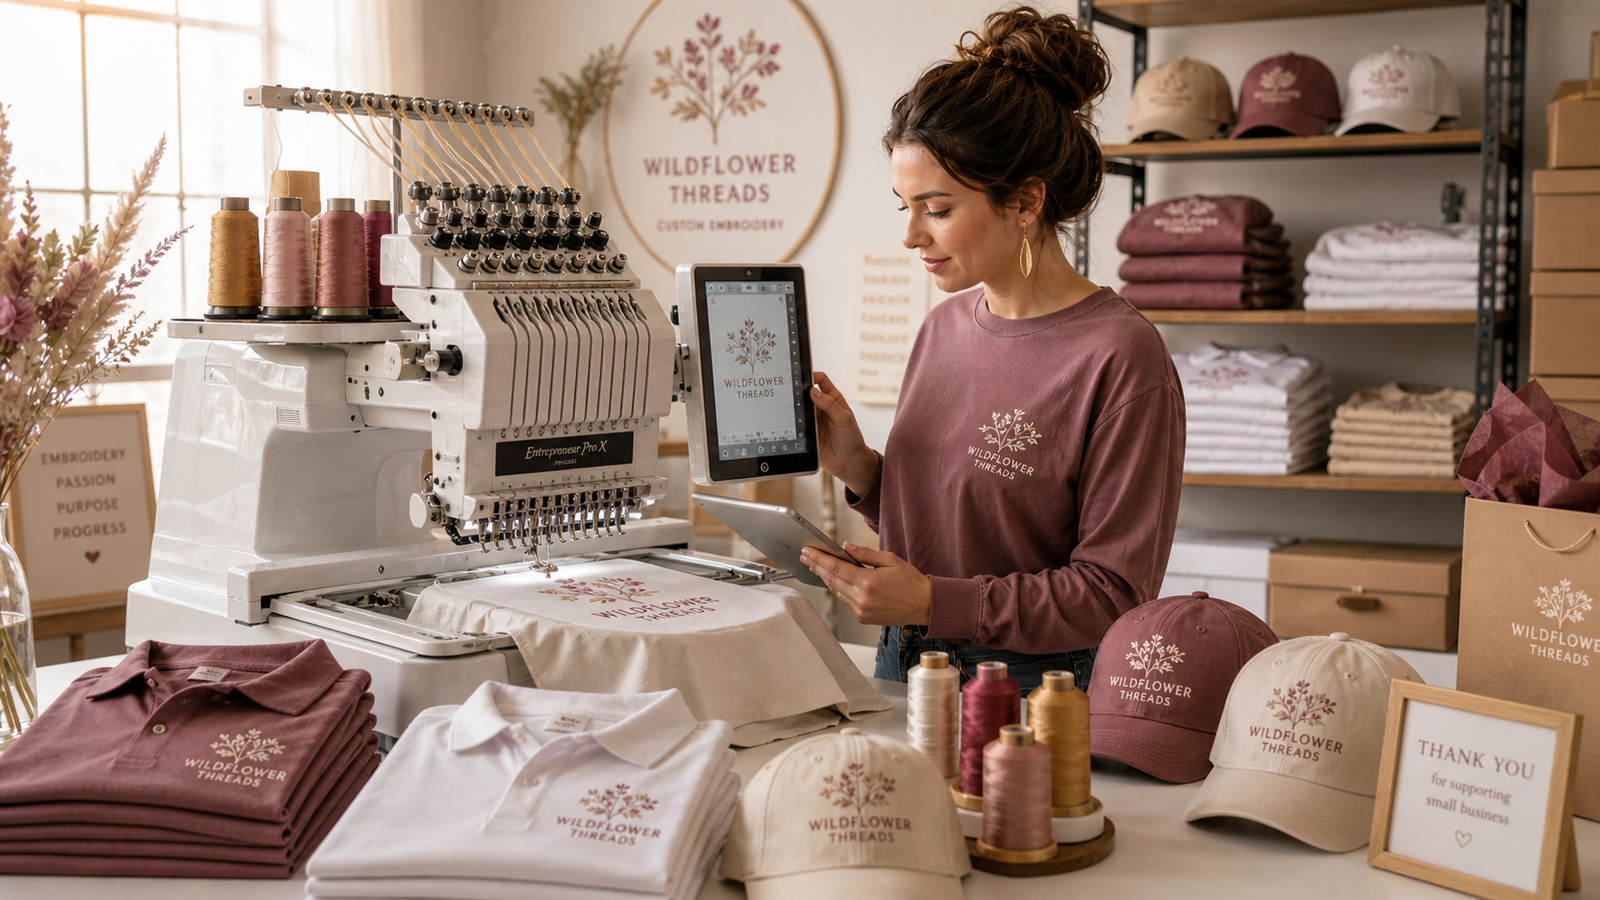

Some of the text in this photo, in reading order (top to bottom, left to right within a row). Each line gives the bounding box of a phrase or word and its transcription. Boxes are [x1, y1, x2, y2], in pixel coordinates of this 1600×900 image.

[643, 153, 797, 177] WILDFLOWER
[669, 183, 771, 204] THREADS
[656, 218, 785, 232] CUSTOM EMBROIDERY
[724, 376, 785, 388] WILDFLOWER
[736, 389, 775, 399] THREADS
[41, 448, 126, 466] EMBROIDERY
[525, 440, 608, 459] Entrepreneur Pro X
[968, 445, 1034, 476] WILDFLOWER
[974, 459, 1016, 480] THREADS
[55, 473, 117, 489] PASSION
[56, 498, 120, 514] PURPOSE
[53, 521, 127, 540] PROGRESS
[591, 596, 720, 619] WILDFLOWER
[636, 605, 716, 622] THREADS
[1511, 622, 1600, 653] WILDFLOWE
[1529, 643, 1589, 666] THREADS
[1110, 676, 1192, 698] WILDFLOWER
[1120, 690, 1171, 706] THREADS
[1250, 726, 1343, 754] WILDFLOWER
[1262, 741, 1320, 762] THREADS
[1418, 739, 1535, 780] THANK YOU
[185, 758, 286, 781] WILDFLOWER
[197, 770, 261, 787] THREADS
[1431, 773, 1512, 806] for supporting
[1426, 796, 1510, 825] small business
[557, 816, 661, 838] WILDFLOWER
[808, 815, 912, 831] WILDFLOWER
[570, 828, 637, 846] THREADS
[829, 831, 895, 843] THREADS
